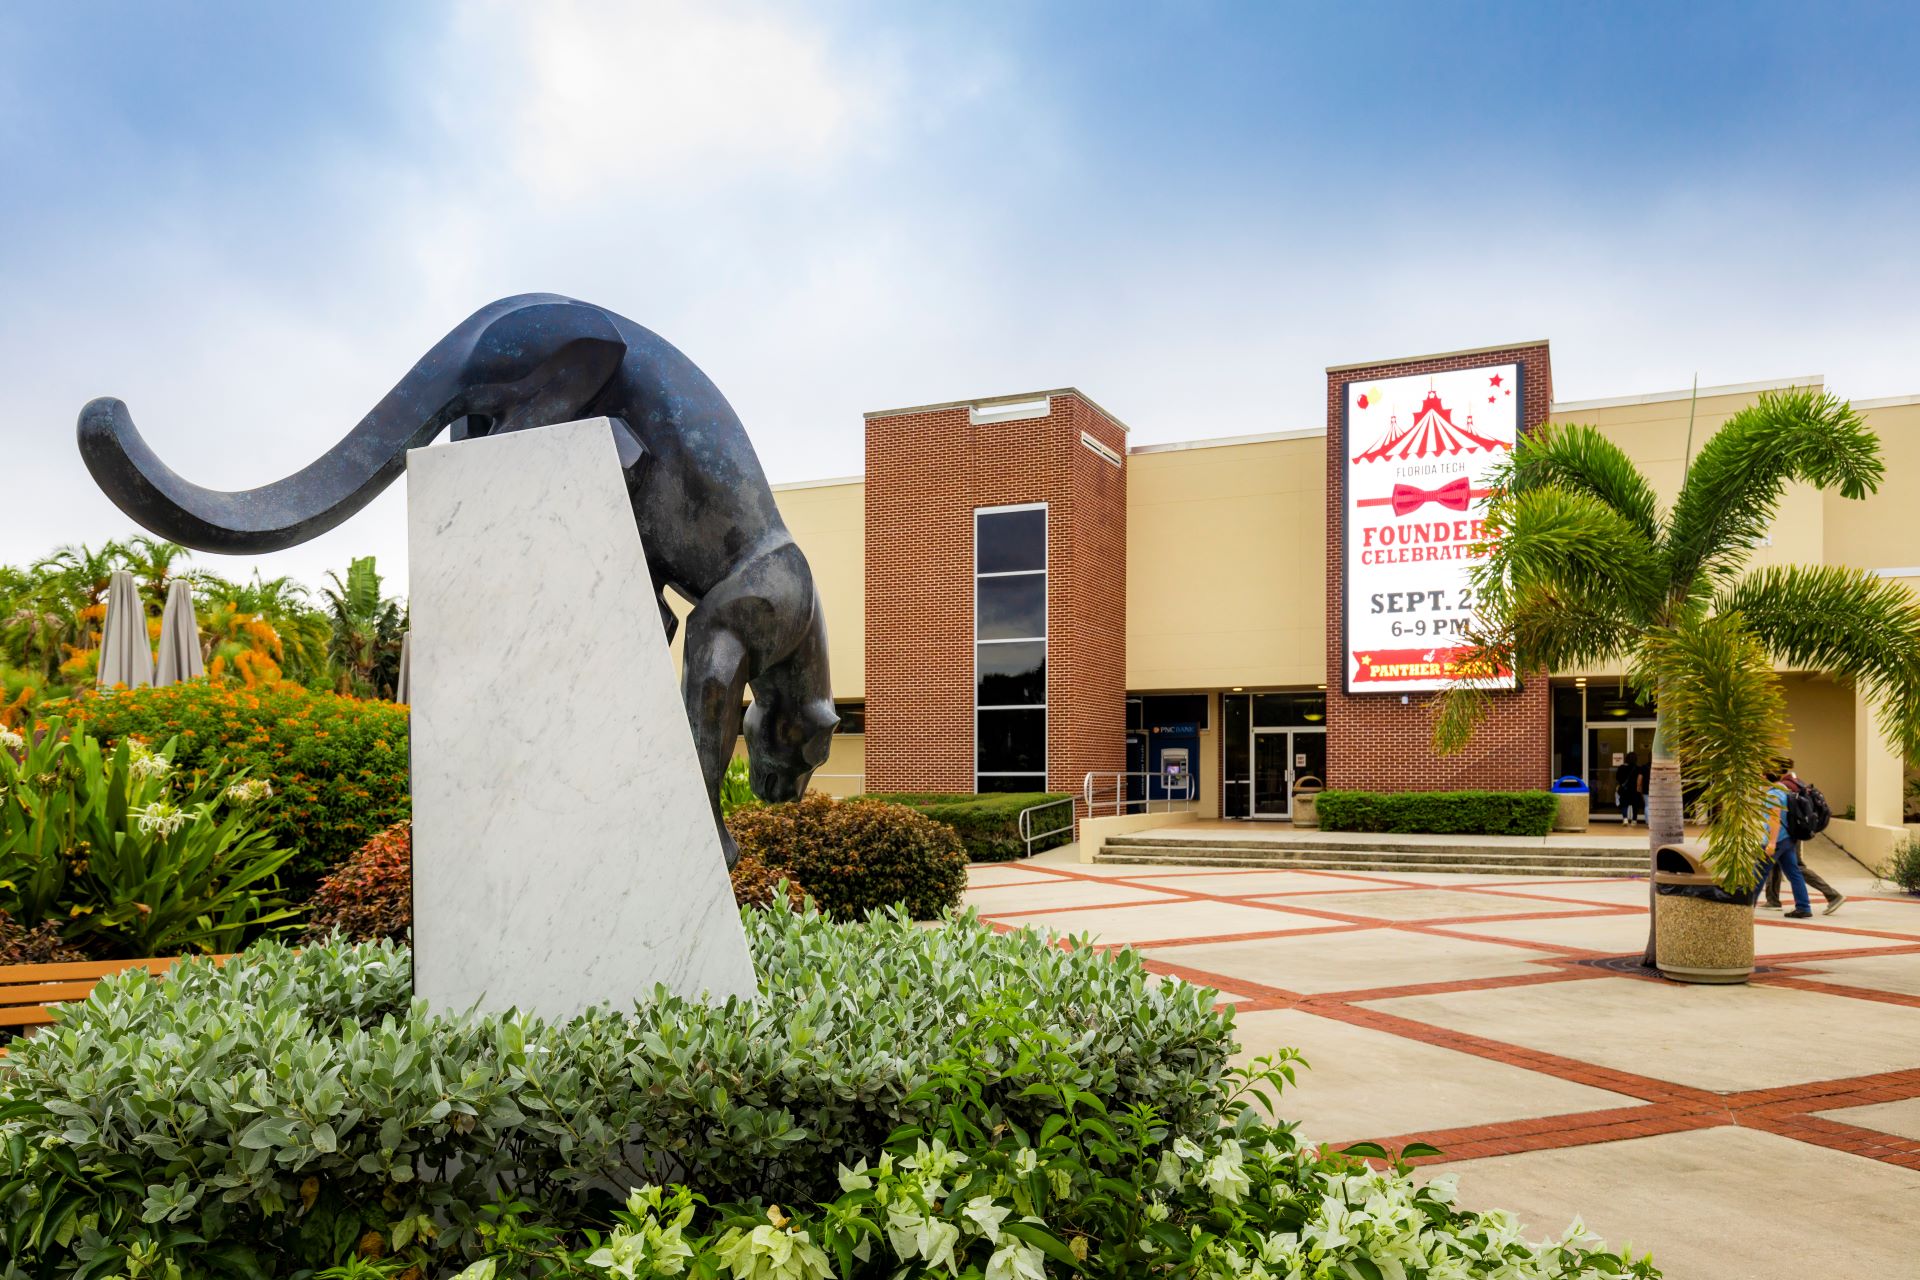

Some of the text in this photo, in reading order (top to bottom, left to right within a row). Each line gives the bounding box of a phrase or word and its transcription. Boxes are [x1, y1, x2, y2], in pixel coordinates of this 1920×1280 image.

[1396, 461, 1465, 478] FLORIDA TECH
[1370, 590, 1452, 614] SEPT.
[1432, 617, 1471, 636] PM
[1369, 662, 1441, 678] PANTHER
